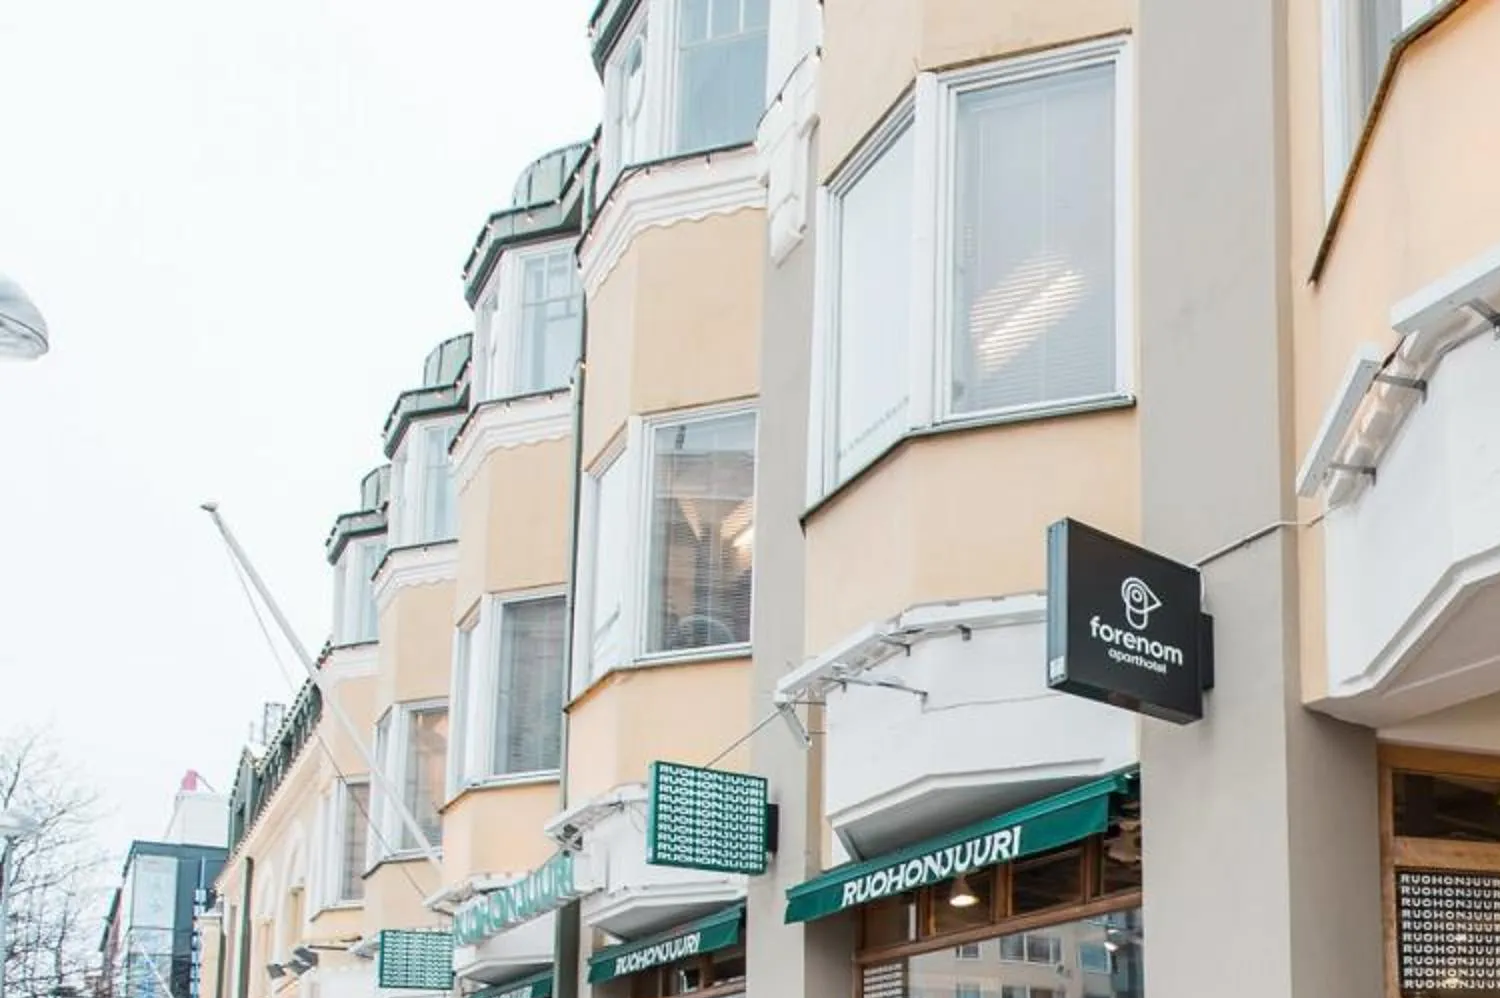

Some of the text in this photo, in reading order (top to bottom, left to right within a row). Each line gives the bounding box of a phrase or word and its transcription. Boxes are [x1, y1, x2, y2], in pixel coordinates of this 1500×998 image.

[1090, 615, 1184, 666] forenom
[1108, 648, 1167, 673] aparthotel
[840, 825, 1022, 907] RUOHONJUURI
[614, 932, 701, 976] RUOHONJUURI
